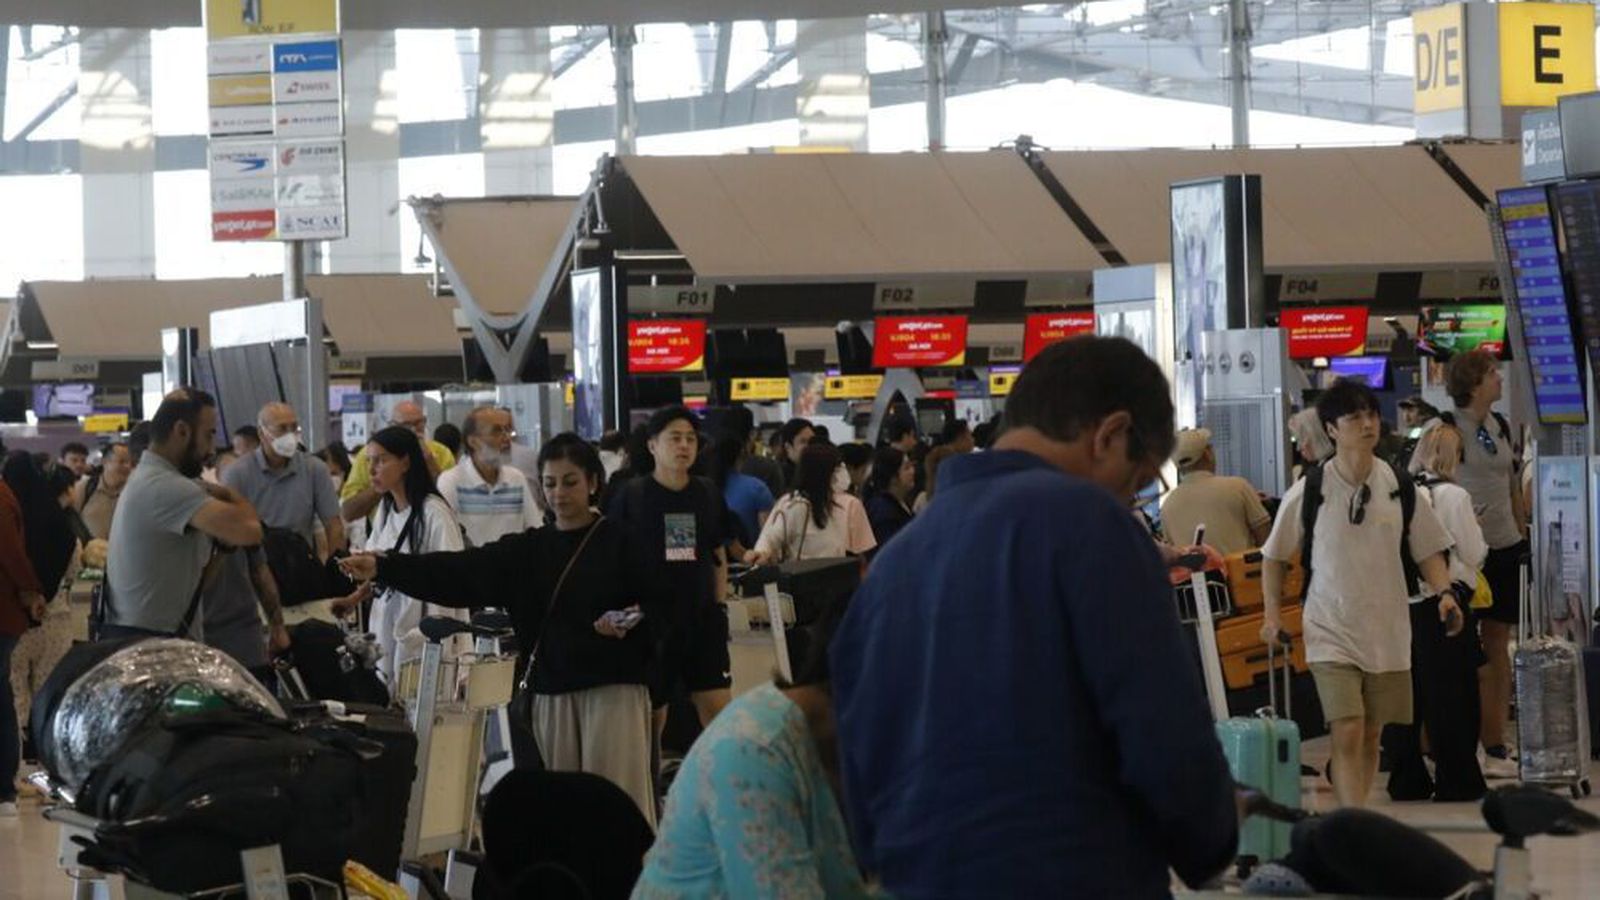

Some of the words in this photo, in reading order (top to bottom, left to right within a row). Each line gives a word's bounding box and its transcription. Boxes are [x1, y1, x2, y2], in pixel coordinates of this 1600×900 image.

[1416, 27, 1460, 91] D/E
[1533, 25, 1564, 84] E
[300, 82, 330, 91] SWISS
[1286, 279, 1318, 294] F04
[1479, 277, 1500, 291] F0
[677, 291, 709, 305] F01
[881, 288, 914, 302] F02
[666, 547, 697, 560] MARVEL
